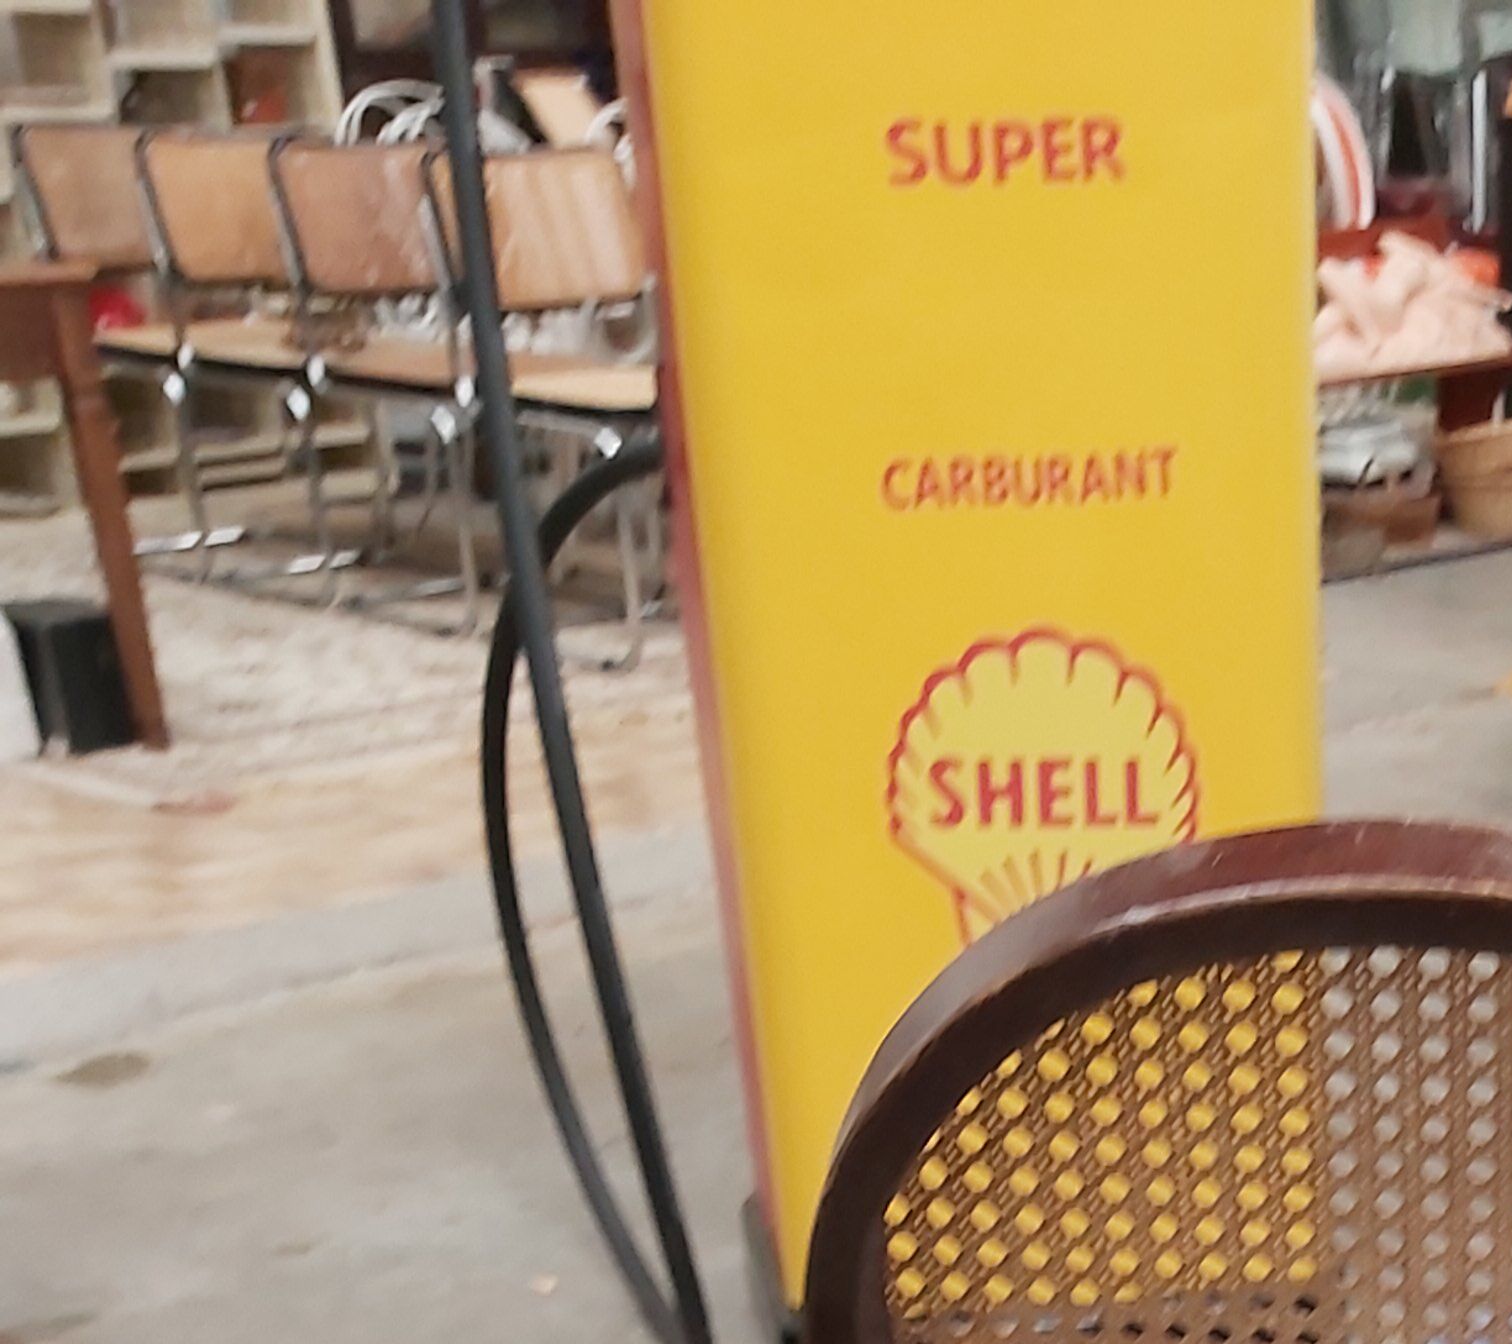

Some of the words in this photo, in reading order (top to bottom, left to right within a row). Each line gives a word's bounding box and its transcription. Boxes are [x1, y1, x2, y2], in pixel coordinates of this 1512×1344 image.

[886, 115, 1126, 188] SUPER
[881, 446, 1177, 511] CARBURANT
[928, 758, 1160, 827] SHELL
